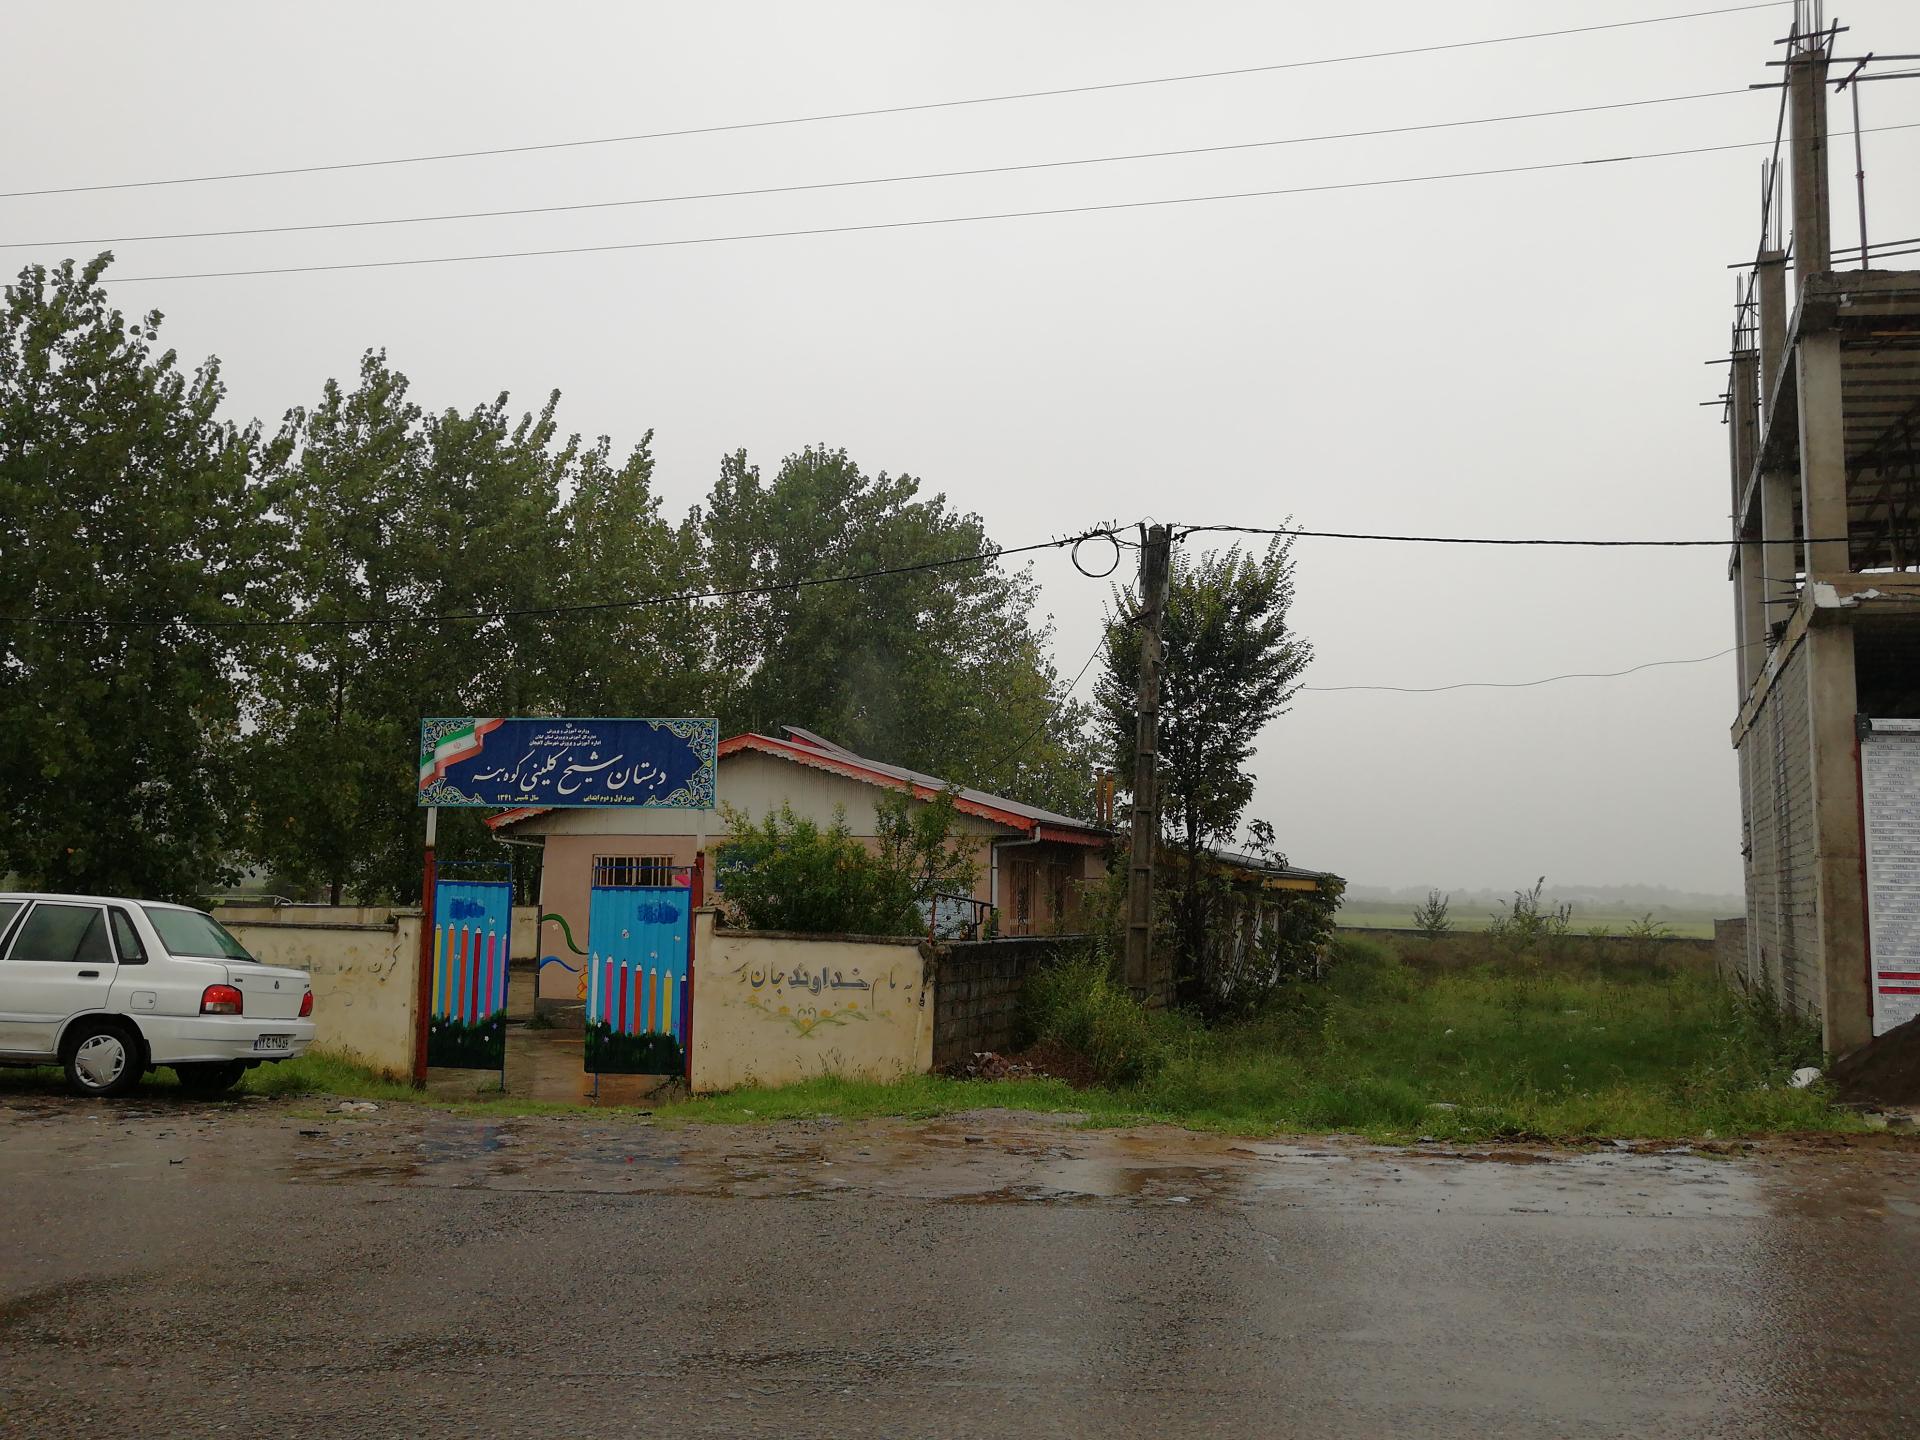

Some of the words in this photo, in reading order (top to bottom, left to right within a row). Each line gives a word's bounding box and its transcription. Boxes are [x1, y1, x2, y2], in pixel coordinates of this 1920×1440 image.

[519, 746, 568, 792] کلینی
[557, 750, 624, 795] شیخ
[606, 760, 667, 791] دبستان
[750, 961, 785, 995] جان
[787, 964, 871, 995] خداوند
